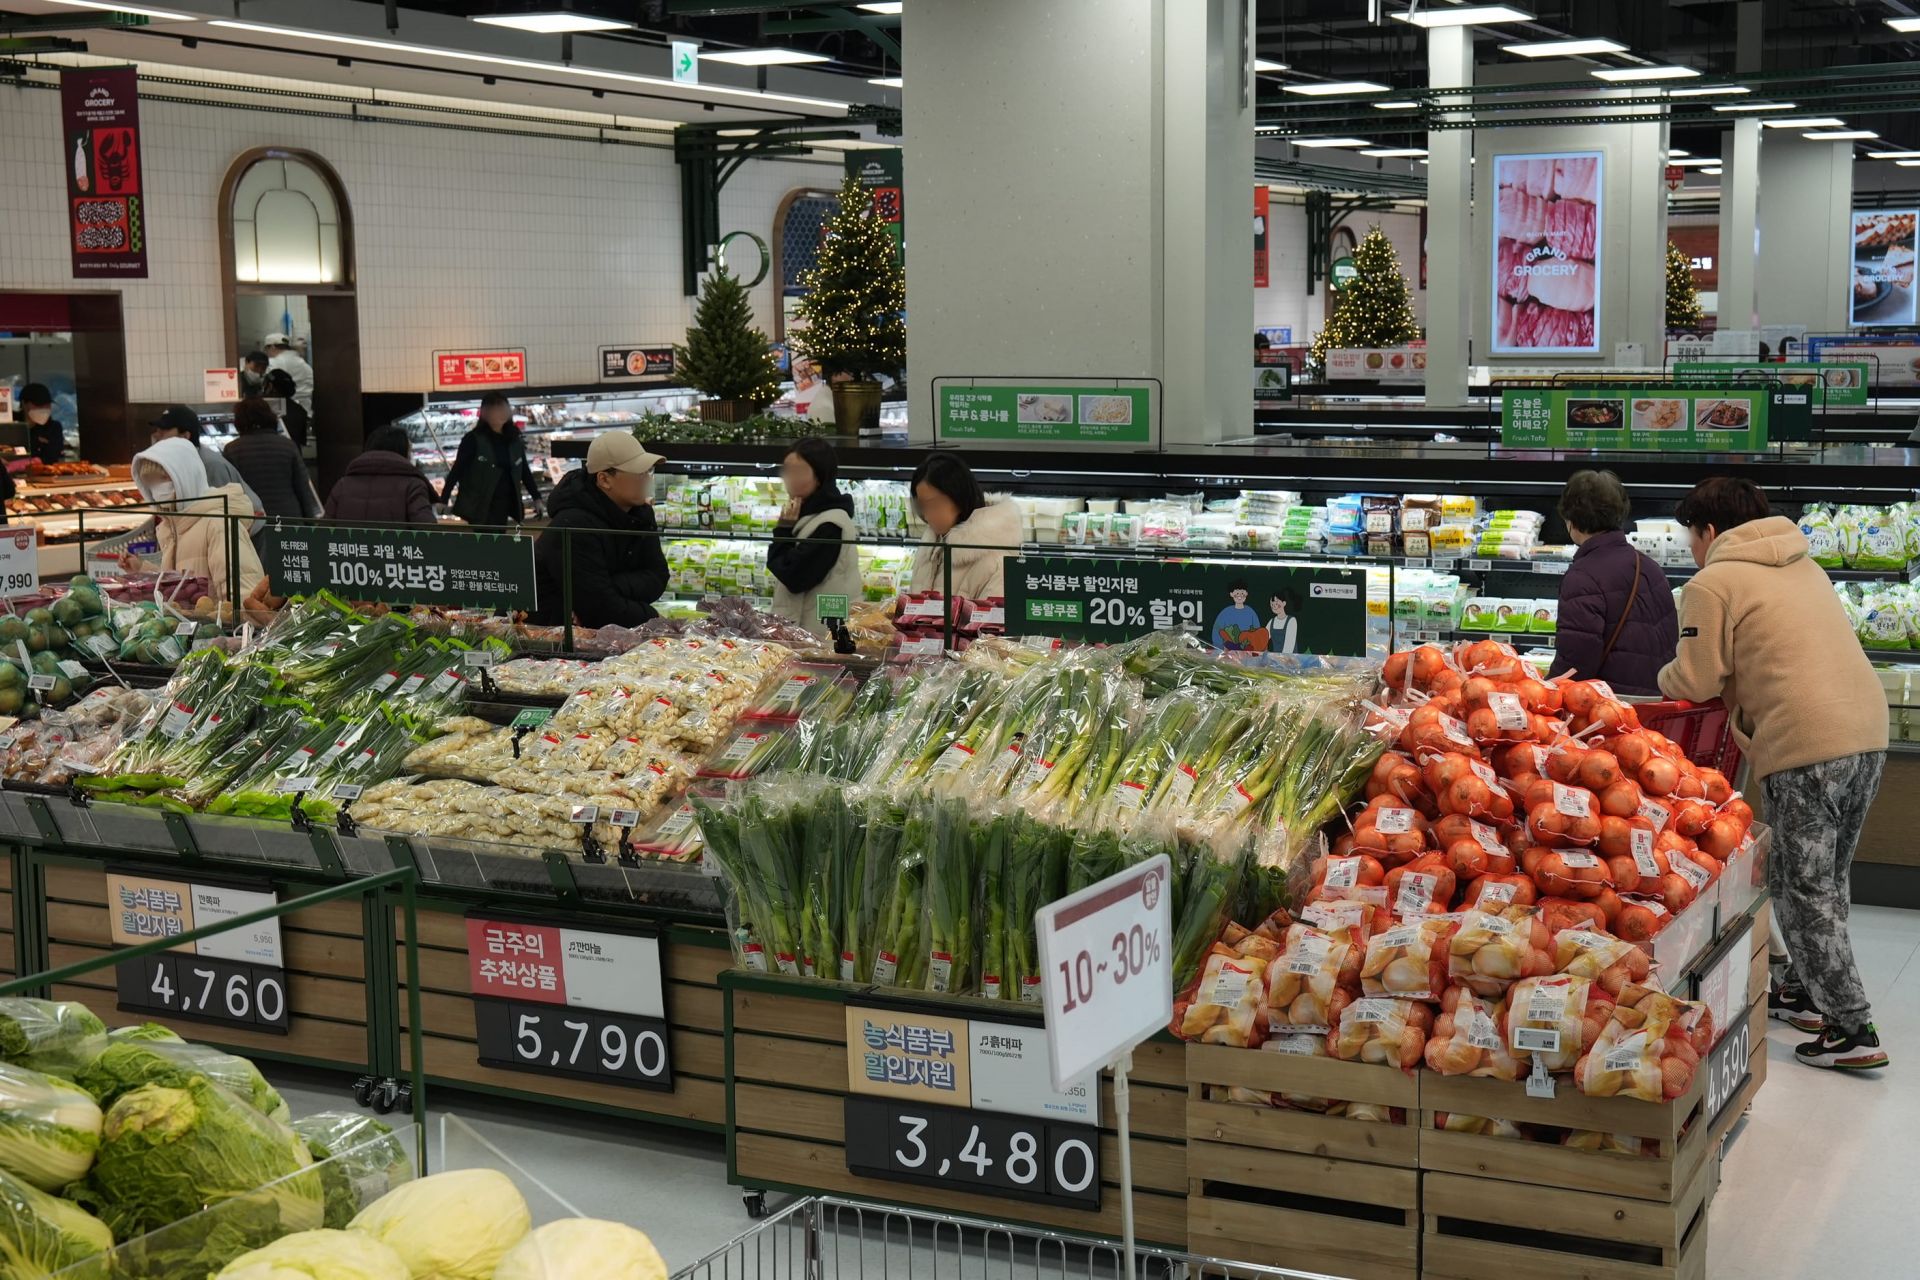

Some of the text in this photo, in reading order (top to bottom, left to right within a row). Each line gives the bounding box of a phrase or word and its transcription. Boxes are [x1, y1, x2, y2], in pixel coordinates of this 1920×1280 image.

[84, 99, 115, 107] GROCERY
[1525, 246, 1568, 262] GRAND
[1513, 264, 1579, 277] GROCERY
[1512, 398, 1542, 409] 오늘은
[949, 410, 970, 422] 두부
[978, 410, 1009, 422] 콩나물
[1512, 409, 1550, 419] 두부요리
[1512, 420, 1549, 430] 어때요?
[280, 540, 308, 551] RE:FRESH
[328, 542, 370, 557] 롯데마트
[281, 554, 310, 569] 신선을
[283, 570, 311, 584] 새롭게
[328, 561, 447, 592] 100% 맛보장
[450, 569, 500, 581] 맛없으면 무조건
[483, 582, 519, 593] 해드립니다
[1025, 574, 1139, 594] 농식품부 할인지원
[1030, 597, 1204, 632] 농할쿠폰 20% 할인
[120, 884, 182, 912] 농식품부
[197, 894, 221, 907] 깐쪽파
[122, 911, 183, 937] 할인지원
[253, 934, 273, 945] 5,950
[486, 929, 544, 959] 금주의
[479, 958, 557, 991] 추천상품
[151, 962, 284, 1021] 4,760
[516, 1014, 666, 1077] 5,790
[863, 1020, 954, 1057] 농식품부
[863, 1052, 955, 1089] 할인지원
[1707, 1023, 1749, 1115] 4,590
[895, 1115, 1094, 1192] 3,480
